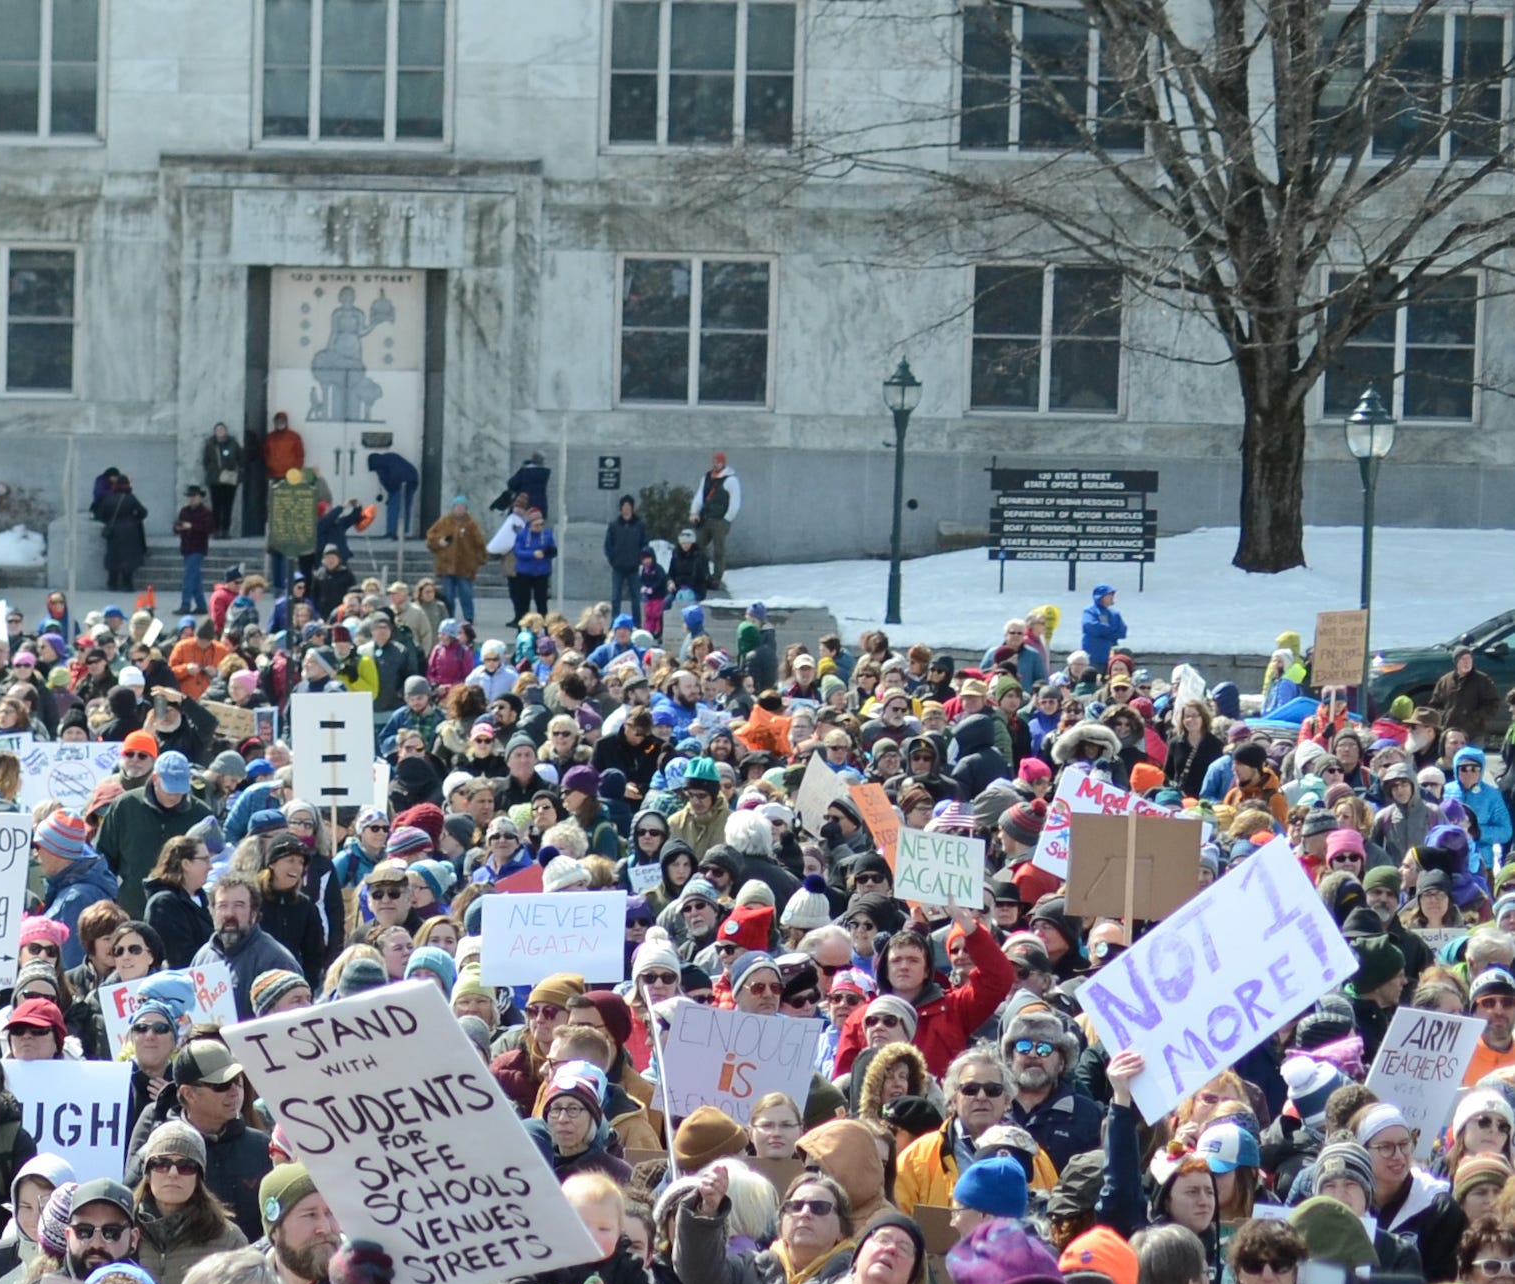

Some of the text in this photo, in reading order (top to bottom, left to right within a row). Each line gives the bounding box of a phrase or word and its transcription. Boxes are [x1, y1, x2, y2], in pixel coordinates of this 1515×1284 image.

[1024, 481, 1048, 489] STATE
[1082, 482, 1125, 490] BUILDINGS
[1081, 473, 1111, 481] STREET
[1003, 510, 1055, 518] DEPARTMENT
[1059, 511, 1069, 519] OF
[1105, 512, 1144, 520] VEHICLES
[1000, 538, 1144, 547] STATE BUILDINGS MAINTENANCE
[1017, 552, 1065, 560] ACCESSIBLE
[899, 834, 970, 868] NEVER
[897, 867, 973, 899] AGAIN
[509, 903, 609, 928] NEVER
[509, 934, 599, 958] AGAIN
[1086, 854, 1301, 1052] NOT 1
[1163, 912, 1336, 1096] MORE!
[245, 1005, 417, 1074] I STAND
[679, 1006, 821, 1081] ENOUGH
[1401, 1016, 1463, 1052] ARM
[321, 1054, 379, 1077] WITH
[1380, 1048, 1459, 1082] TEACHERS
[279, 1074, 495, 1154] STUDENTS
[378, 1130, 427, 1151] FOR
[355, 1144, 467, 1192] SAFE
[364, 1166, 531, 1226] SCHOOLS
[401, 1203, 531, 1250] VENUES
